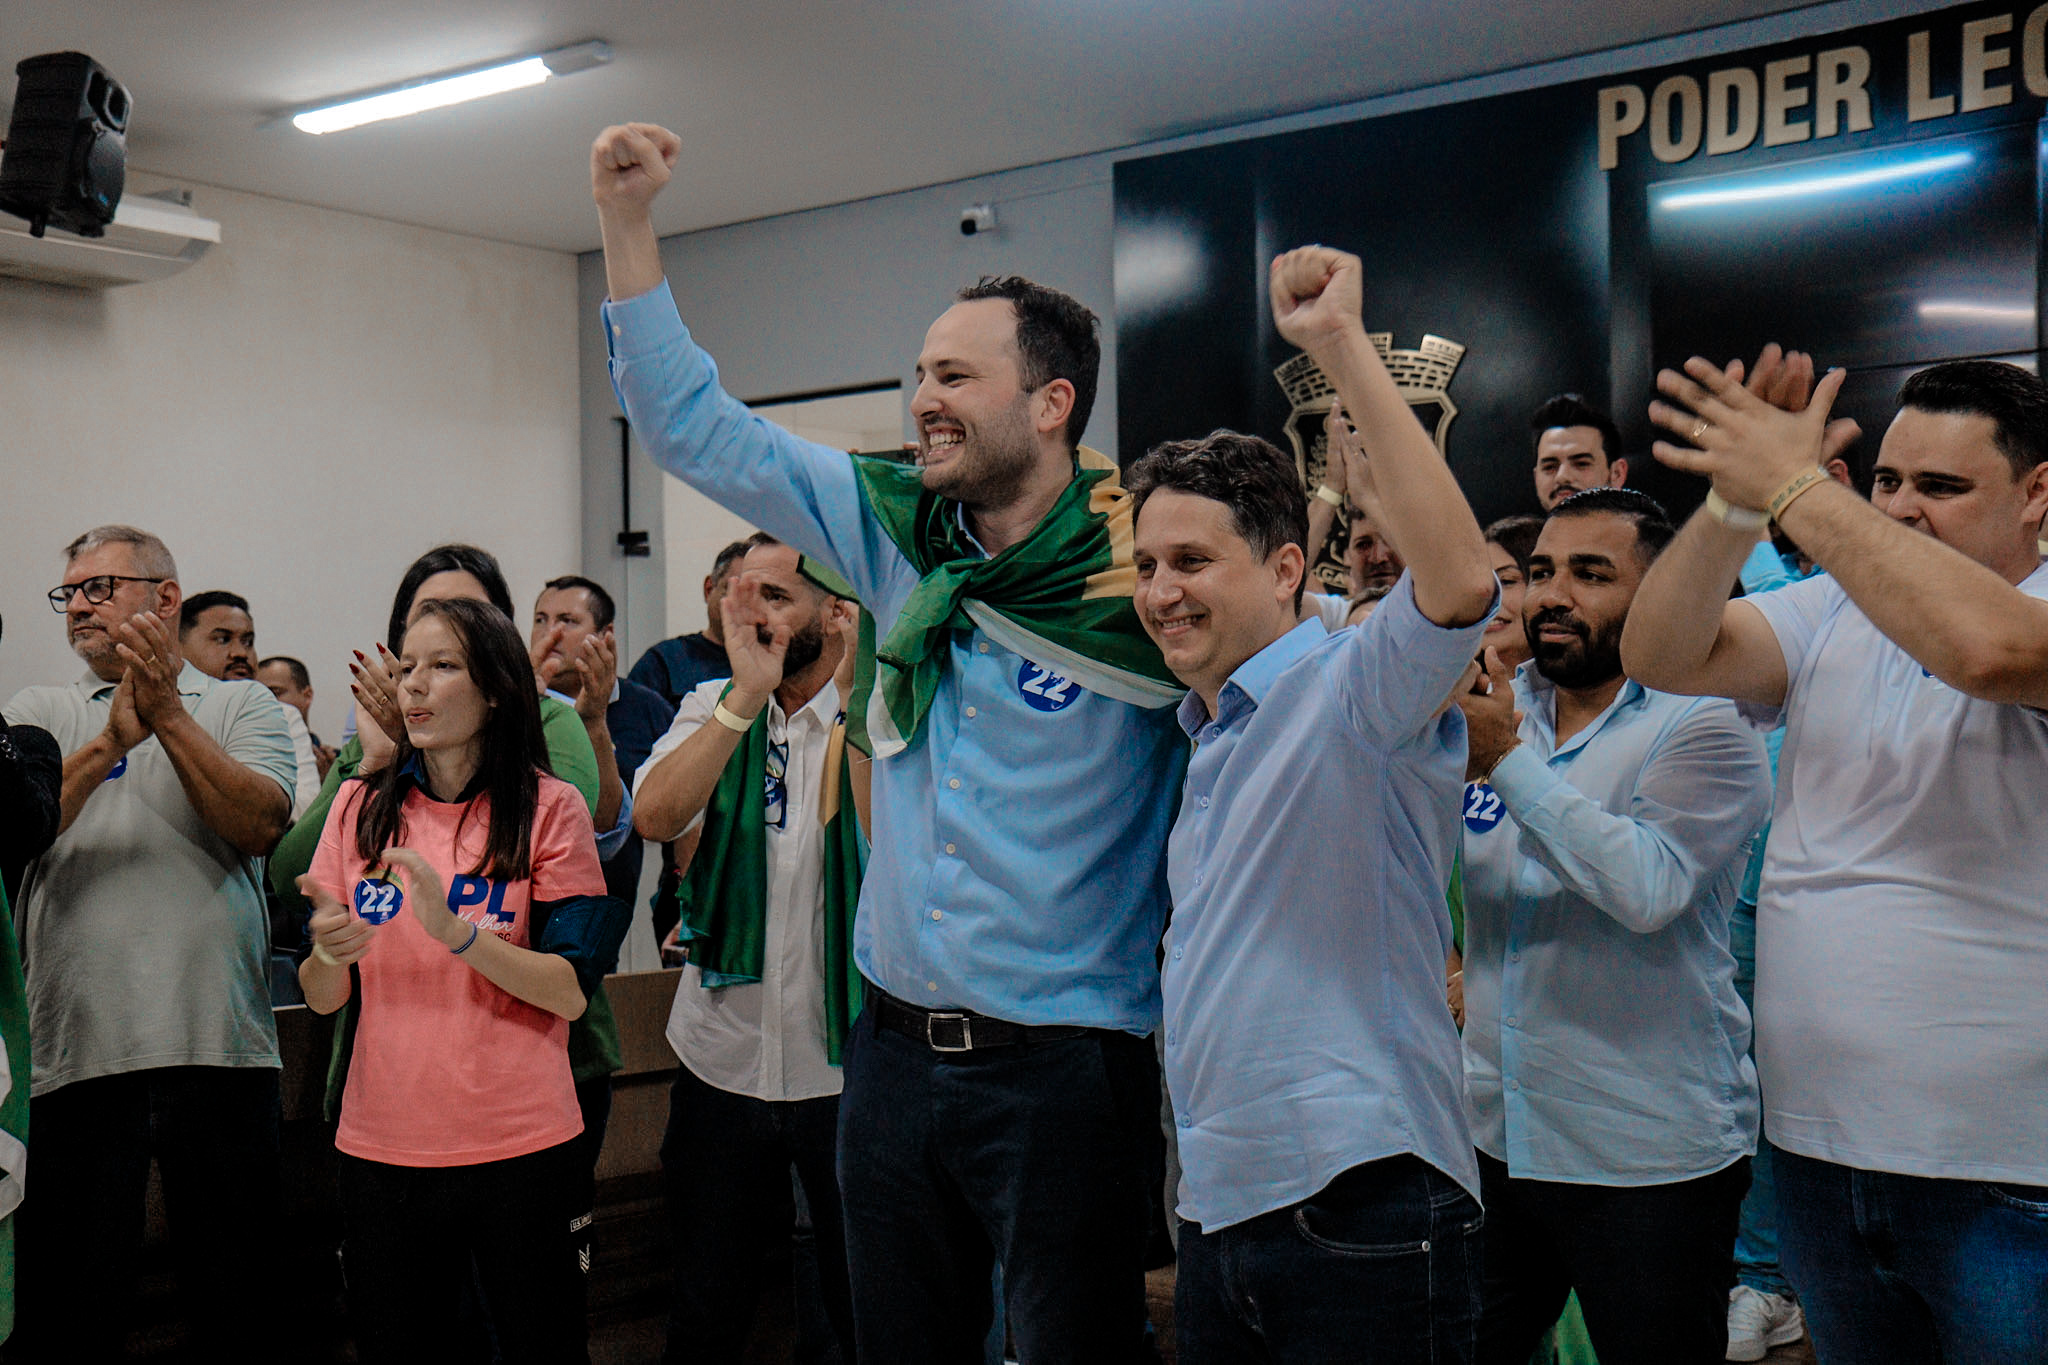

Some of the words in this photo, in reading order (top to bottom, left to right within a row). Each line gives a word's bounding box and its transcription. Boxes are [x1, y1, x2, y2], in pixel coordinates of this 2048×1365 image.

[1598, 45, 1875, 171] PODER
[1021, 663, 1073, 703] 22
[1465, 789, 1501, 822] 22
[360, 884, 396, 914] 22
[446, 873, 517, 923] PL
